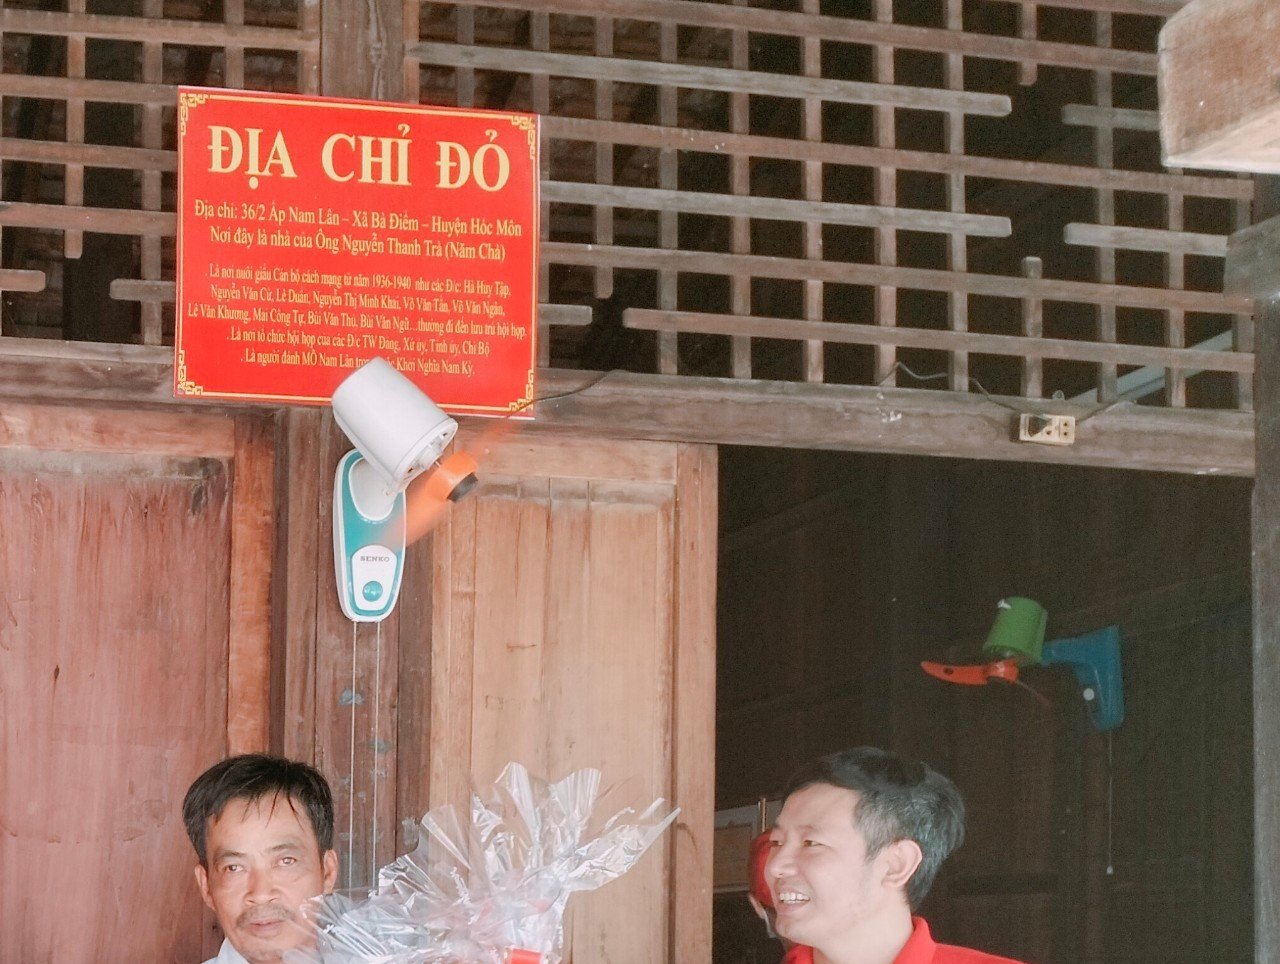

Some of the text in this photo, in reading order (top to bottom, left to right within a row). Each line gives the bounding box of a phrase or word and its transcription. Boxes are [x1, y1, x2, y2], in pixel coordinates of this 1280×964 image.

[207, 123, 510, 192] ĐỊA CHỈ ĐỎ
[194, 198, 215, 220] Địa
[241, 202, 266, 220] 36/2
[289, 206, 315, 223] Nam
[318, 207, 340, 225] Lân
[352, 210, 368, 227] Xã
[371, 211, 386, 228] Bà
[389, 210, 419, 230] Điểm
[431, 214, 467, 238] Huyện
[470, 217, 493, 235] Hóc
[496, 218, 522, 236] Môn
[210, 225, 231, 242] Nơi
[234, 226, 254, 248] đây
[257, 228, 268, 245] là
[270, 229, 291, 246] nhà
[293, 231, 313, 248] của
[315, 227, 339, 254] Ông
[342, 230, 384, 257] Nguyễn
[387, 236, 422, 255] Thanh
[445, 240, 476, 261] (Năm
[209, 263, 220, 277] Là
[221, 265, 234, 278] nơi
[236, 265, 253, 279] nuôi
[255, 264, 272, 283] giấu
[290, 269, 300, 283] bộ
[301, 269, 320, 283] cách
[321, 273, 342, 288] mạng
[353, 273, 370, 286] năm
[372, 274, 412, 289] 1936-1940
[415, 277, 430, 290] như
[431, 278, 444, 291] các
[464, 279, 475, 293] Hà
[476, 280, 493, 297] Huy
[210, 281, 241, 302] Nguyễn
[242, 286, 258, 299] Văn
[276, 288, 286, 301] Lê
[313, 287, 342, 308] Nguyễn
[344, 292, 357, 309] Thị
[359, 293, 379, 308] Minh
[416, 297, 432, 311] Văn
[465, 299, 481, 314] Văn
[188, 302, 199, 316] Lê
[199, 303, 216, 318] Văn
[253, 307, 268, 321] Mai
[270, 308, 291, 326] Công
[307, 310, 321, 325] Bùi
[323, 311, 339, 326] Văn
[360, 313, 374, 327] Bùi
[375, 314, 391, 329] Văn
[445, 319, 454, 332] đi
[455, 315, 469, 333] đến
[497, 322, 509, 337] hội
[231, 326, 241, 340] Là
[243, 327, 256, 341] nơi
[267, 329, 285, 343] chức
[287, 330, 300, 346] hội
[301, 332, 315, 347] họp
[332, 333, 345, 346] các
[362, 335, 378, 348] TW
[478, 341, 490, 357] Bộ
[245, 347, 256, 362] Là
[257, 349, 280, 366] người
[281, 350, 301, 364] đánh
[319, 352, 337, 366] Nam
[417, 358, 440, 376] Nghĩa
[441, 359, 460, 373] Nam
